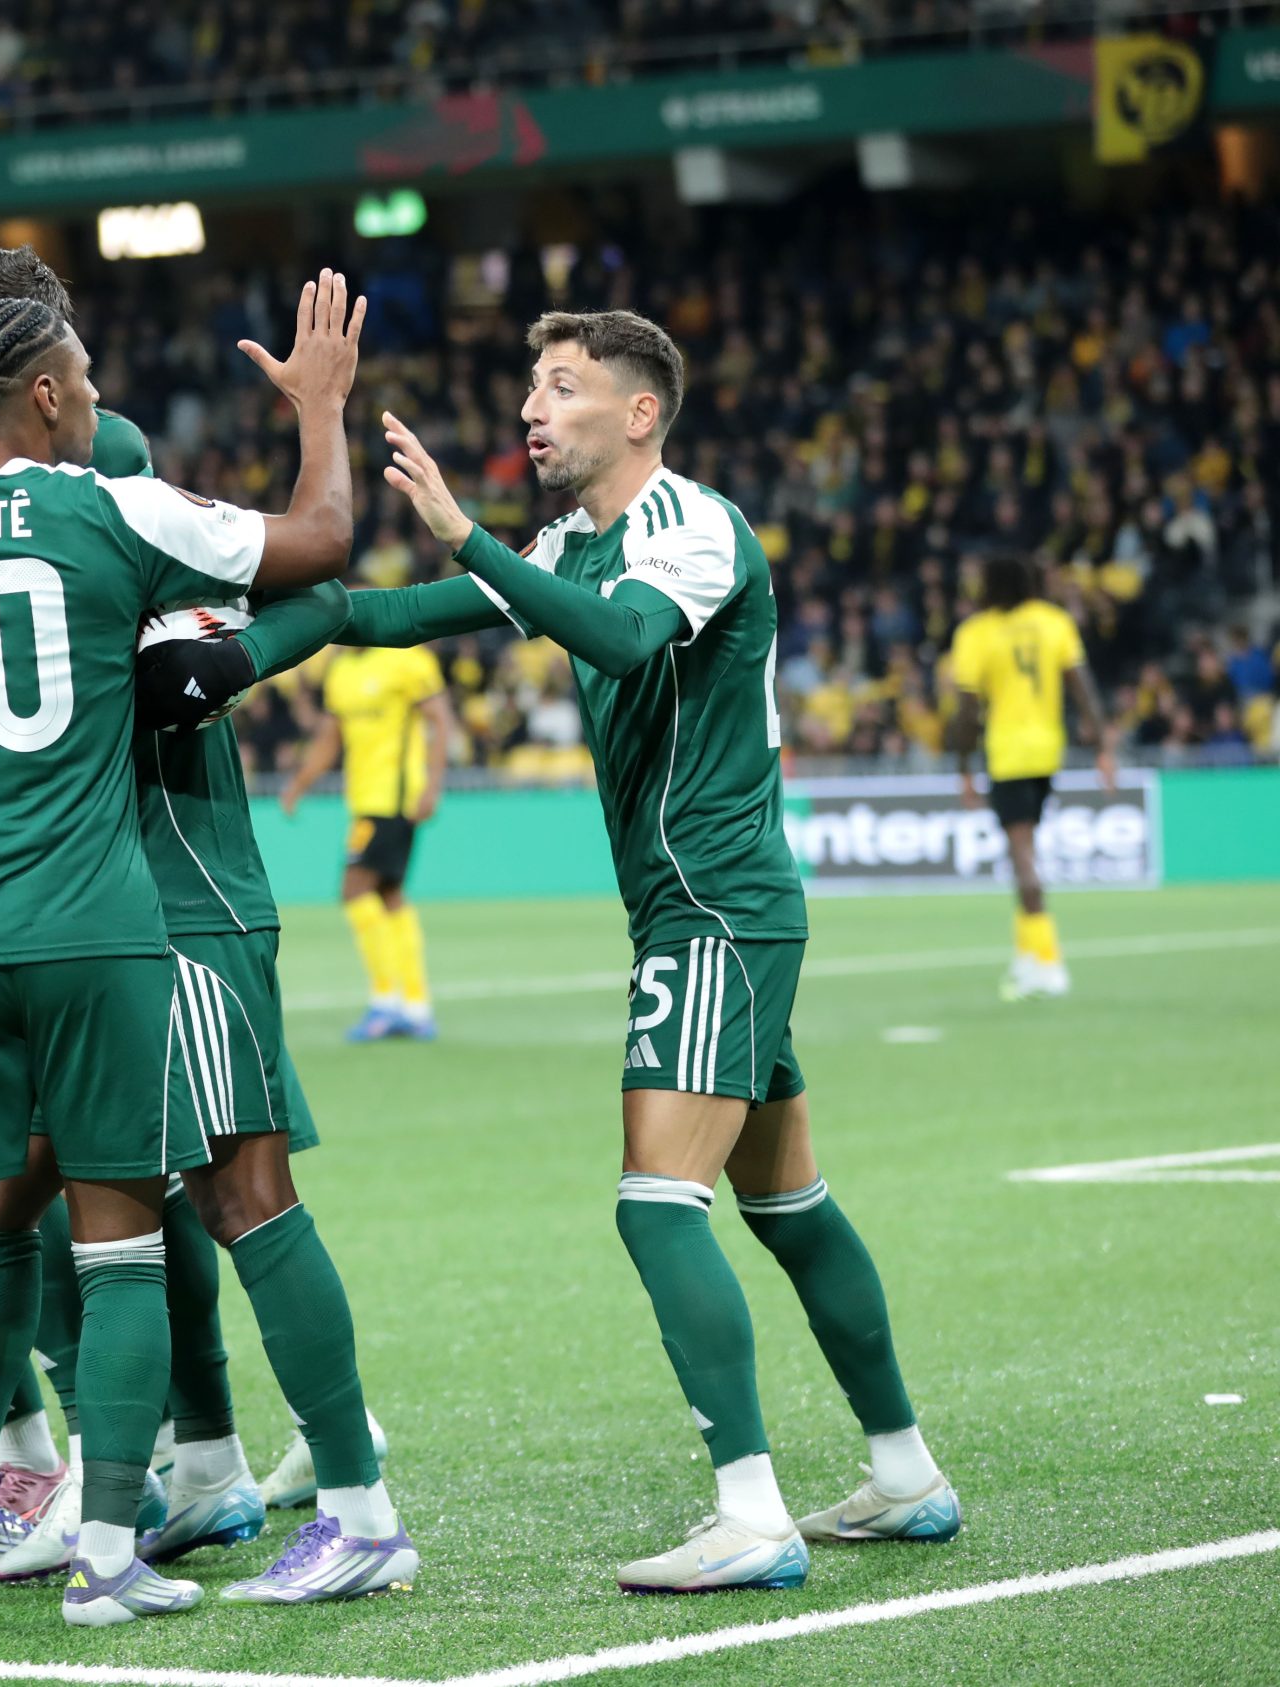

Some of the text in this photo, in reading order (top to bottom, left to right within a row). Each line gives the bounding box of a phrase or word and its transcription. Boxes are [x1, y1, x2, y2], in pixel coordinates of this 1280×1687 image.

[1011, 644, 1043, 699] 4
[783, 800, 1147, 874] nterpise
[627, 956, 679, 1034] 5
